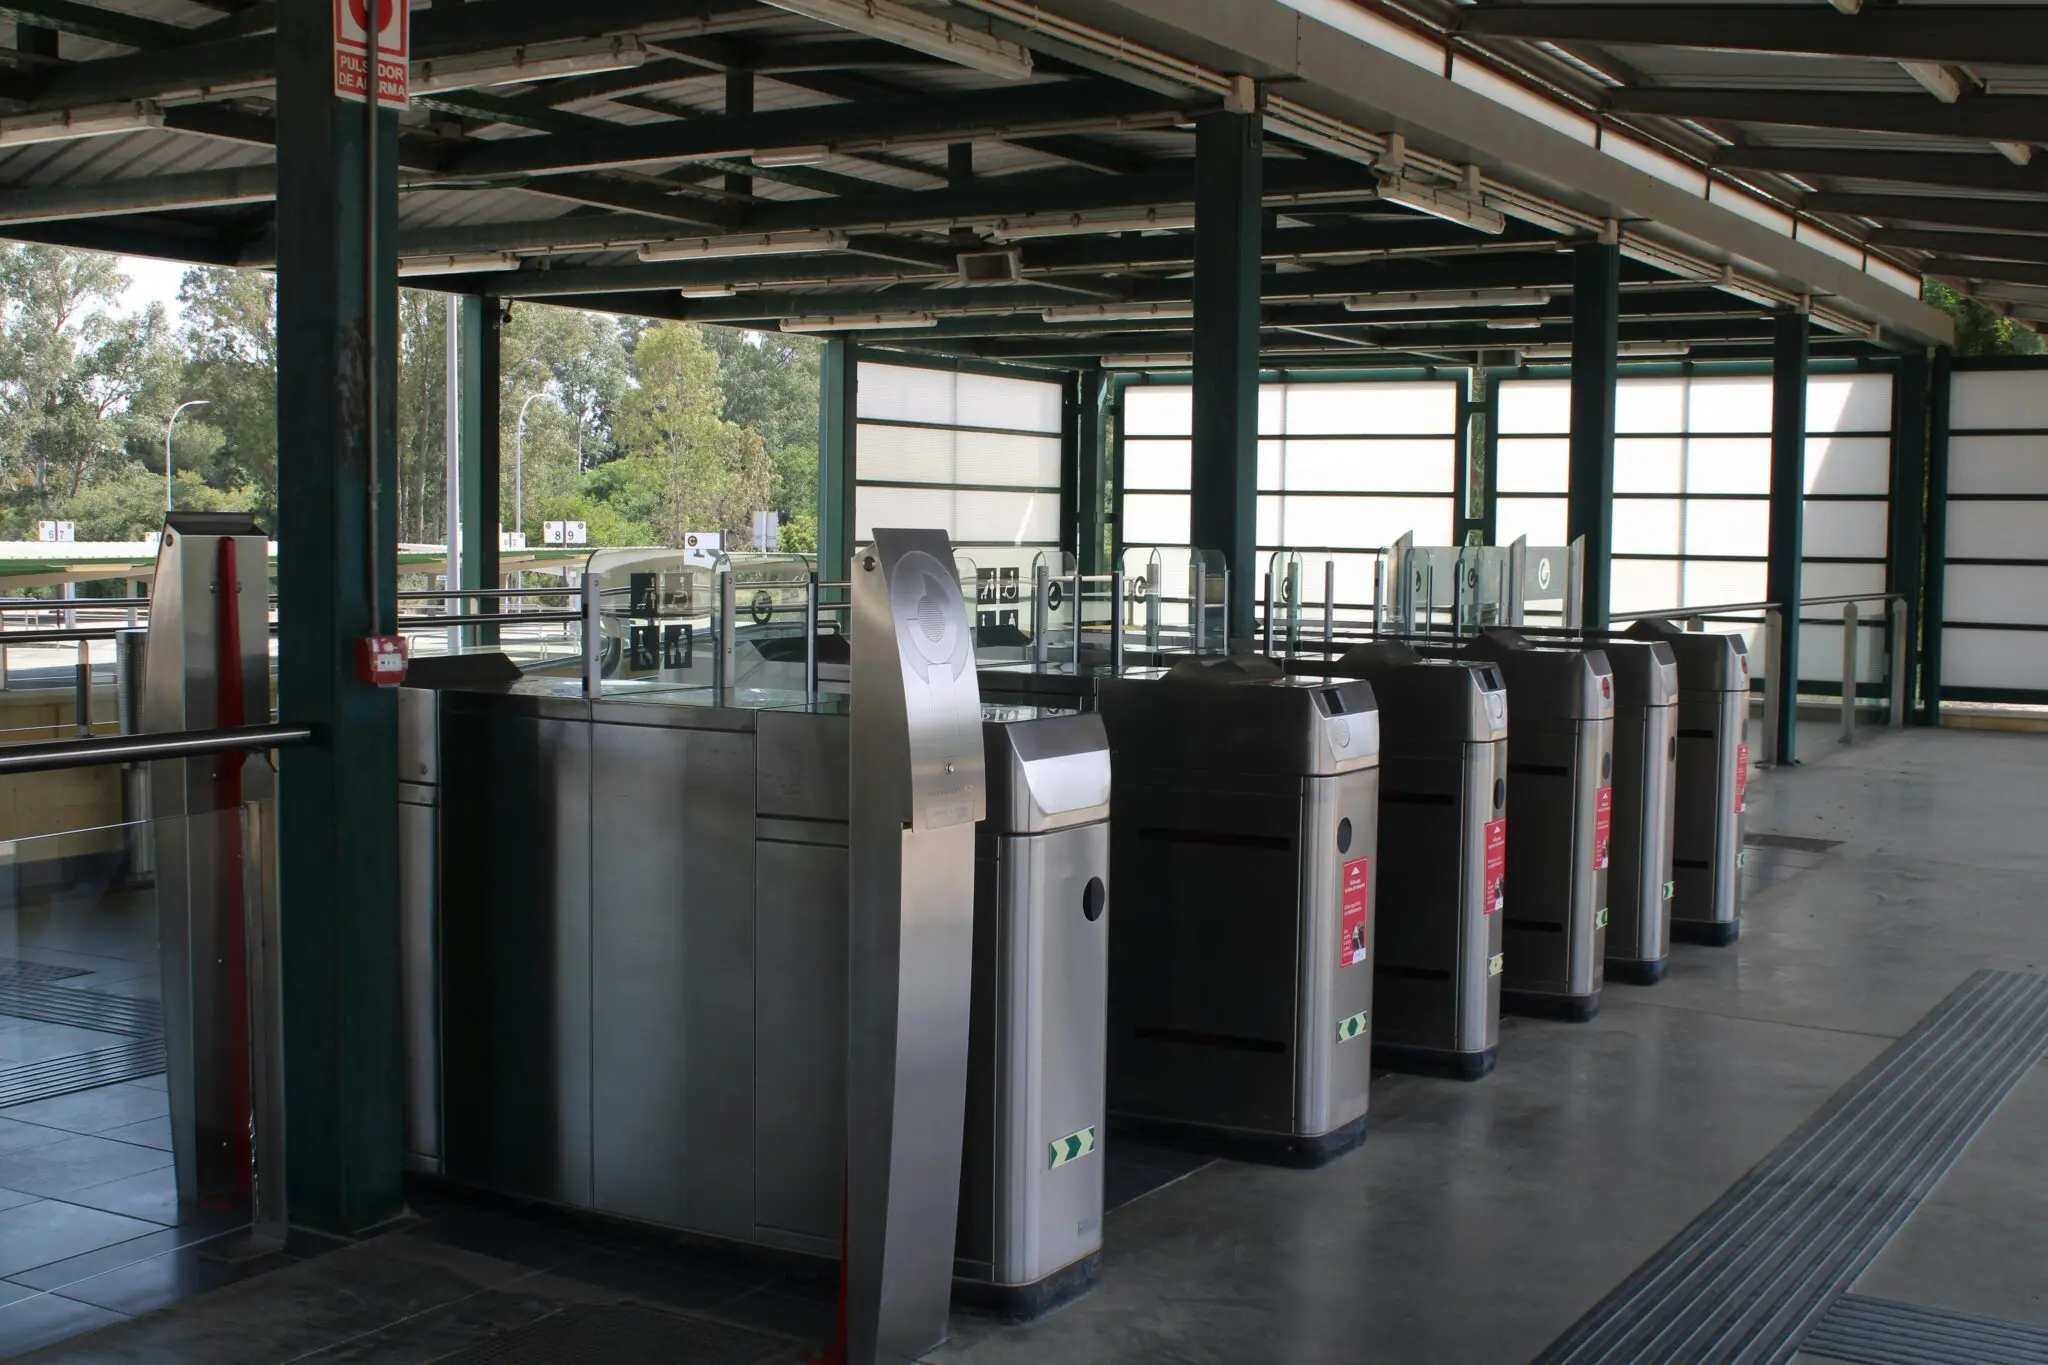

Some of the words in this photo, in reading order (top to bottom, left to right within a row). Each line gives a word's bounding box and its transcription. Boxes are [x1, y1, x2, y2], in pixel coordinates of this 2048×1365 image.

[340, 55, 404, 81] PULSDOR
[339, 71, 354, 87] DE
[356, 76, 405, 97] ARMA
[48, 530, 54, 539] 6
[60, 530, 64, 540] 7
[554, 530, 562, 540] 8
[567, 530, 574, 540] 9
